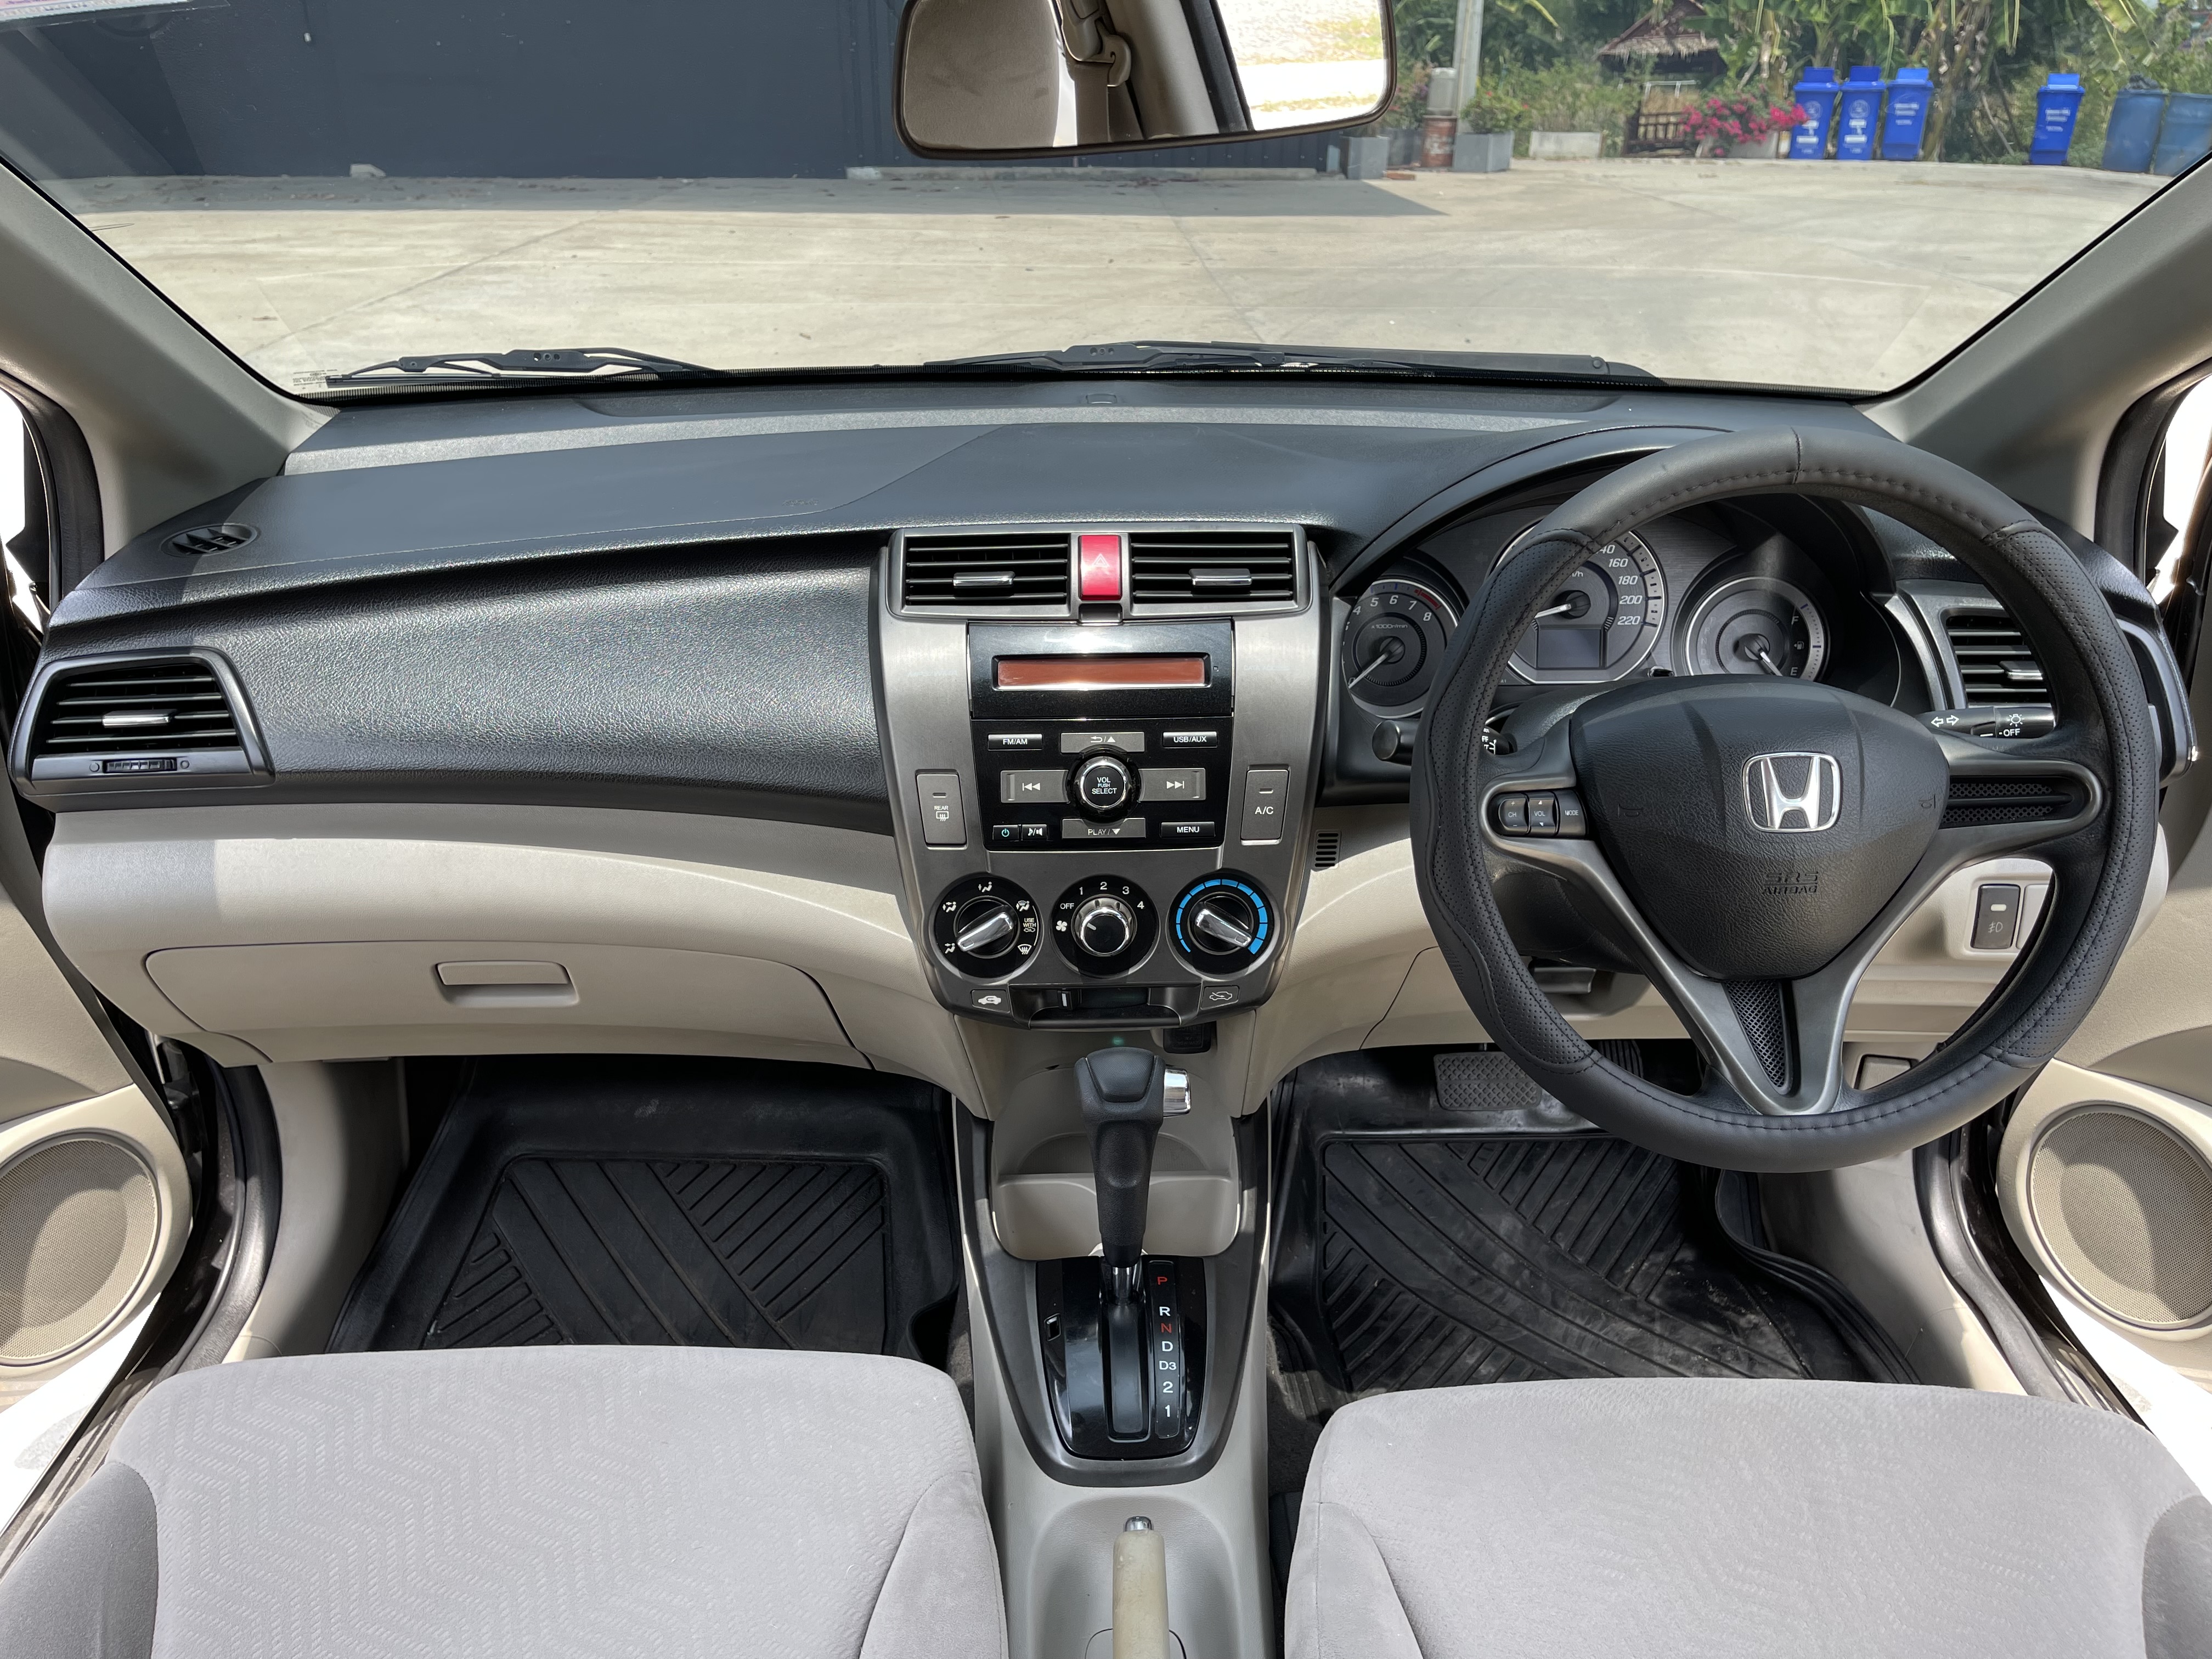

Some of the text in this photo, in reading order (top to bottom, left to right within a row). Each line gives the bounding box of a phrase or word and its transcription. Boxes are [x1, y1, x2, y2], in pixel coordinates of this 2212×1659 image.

[1596, 544, 1616, 554] 40
[1609, 558, 1629, 568] 160
[1618, 575, 1639, 585] 180
[1619, 595, 1643, 605] 200
[1352, 595, 1432, 622] 4 5 6 7 8
[1617, 616, 1641, 625] 220
[1791, 616, 1799, 625] F
[1790, 667, 1798, 676] E
[1254, 806, 1274, 815] A/C
[1765, 871, 1819, 883] SRS
[1762, 885, 1818, 895] AIRBAG
[1079, 881, 1144, 910] 1 2 3 4
[1157, 1276, 1168, 1285] P
[1159, 1306, 1171, 1317] R
[1160, 1322, 1172, 1334] N
[1161, 1341, 1173, 1352] D
[1159, 1360, 1177, 1370] D3
[1163, 1381, 1173, 1393] 2
[1165, 1404, 1171, 1418] 1
